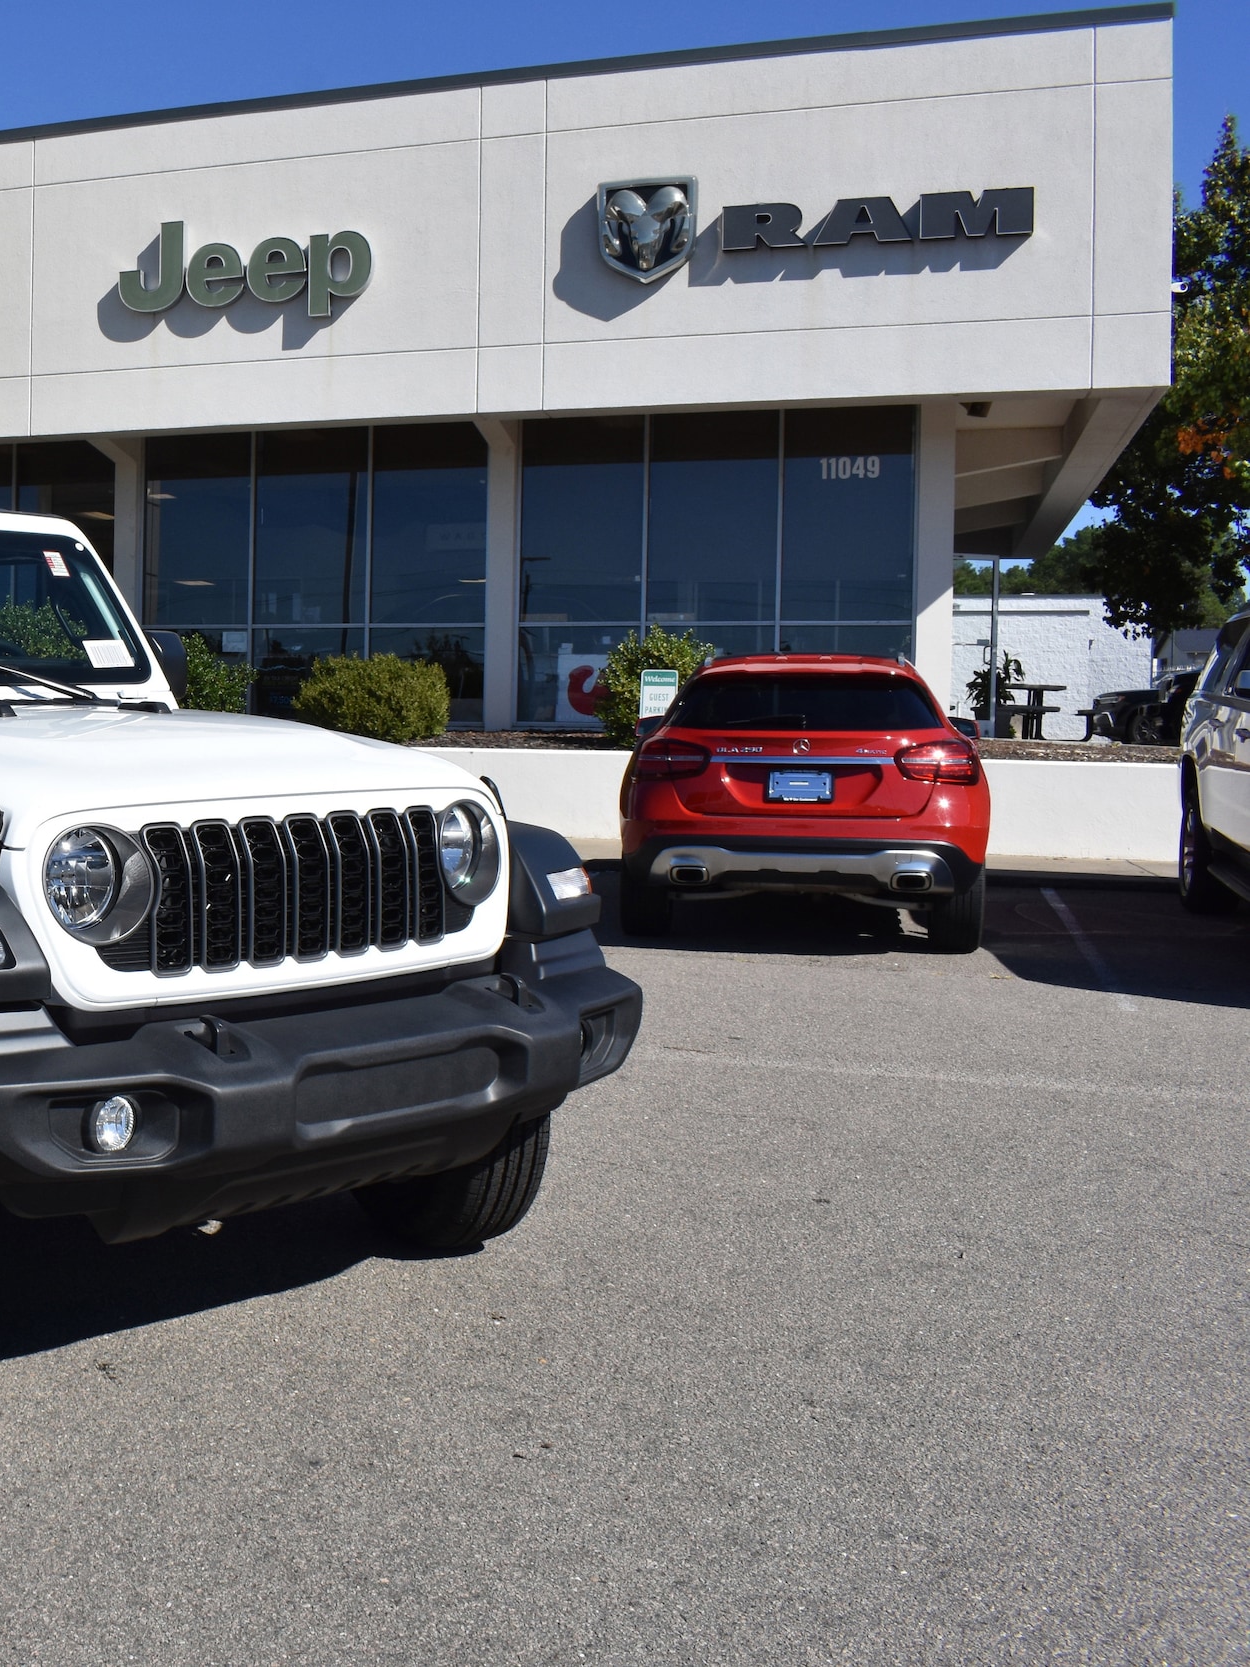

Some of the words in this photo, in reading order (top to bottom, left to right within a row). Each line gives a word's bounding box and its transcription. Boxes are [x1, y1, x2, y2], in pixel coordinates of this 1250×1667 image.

[722, 186, 1035, 252] RAM
[117, 220, 373, 318] Jeep
[819, 455, 881, 480] 11049
[644, 675, 676, 683] Welcome
[649, 693, 669, 702] GUEST
